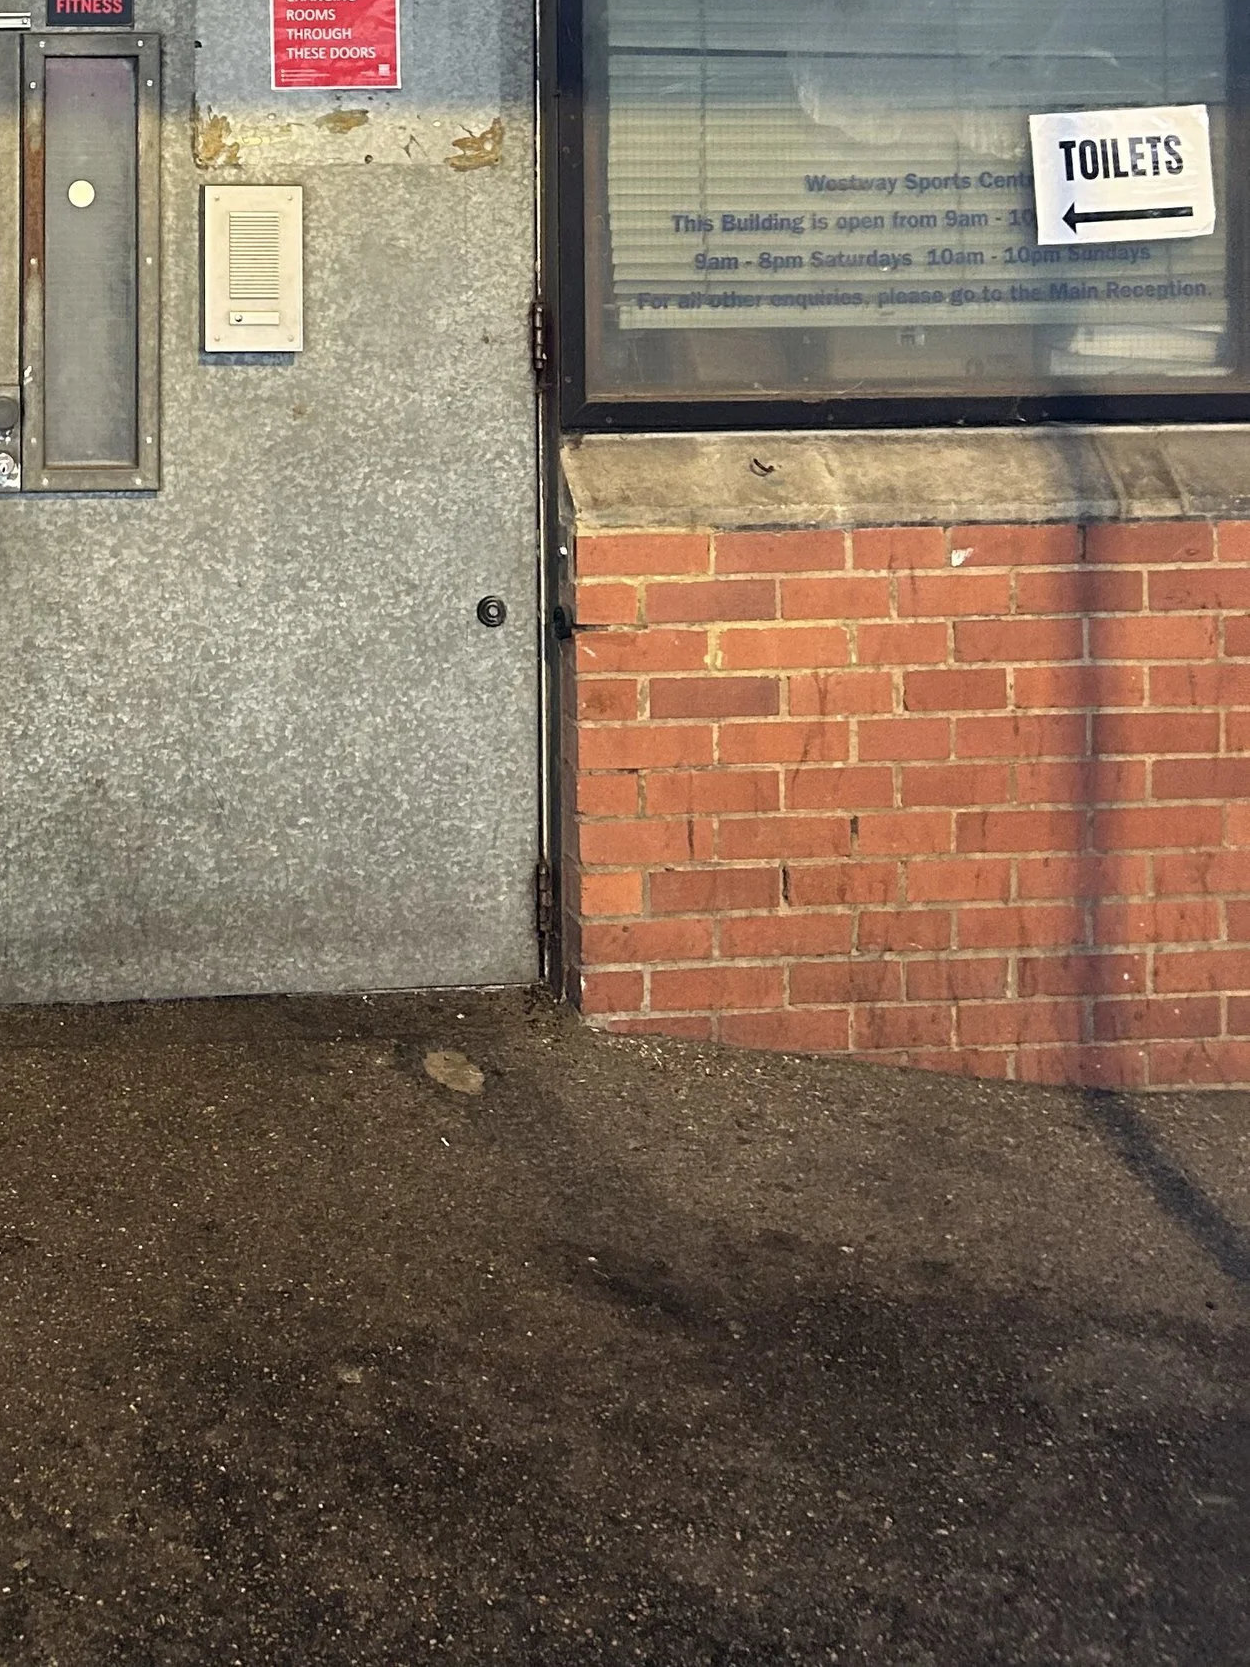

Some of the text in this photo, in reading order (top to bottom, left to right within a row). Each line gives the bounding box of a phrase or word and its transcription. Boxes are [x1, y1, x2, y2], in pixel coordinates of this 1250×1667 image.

[286, 8, 336, 21] ROOMS
[286, 27, 352, 40] THROUGH
[286, 46, 377, 60] THESE DOORS
[1058, 134, 1184, 182] TOILETS
[804, 174, 897, 195] Westway
[904, 172, 971, 194] Sports
[671, 214, 715, 233] This
[720, 212, 805, 234] Building
[810, 212, 828, 231] is
[836, 213, 885, 234] open
[892, 210, 938, 229] from
[944, 209, 989, 228] 9am
[694, 252, 739, 271] 9am
[757, 251, 804, 272] 8pm
[810, 248, 913, 271] Saturdays
[926, 247, 985, 267] 10am
[1003, 245, 1061, 267] 10pm
[1067, 243, 1152, 264] Sundays
[636, 292, 671, 309] For
[677, 290, 700, 309] all
[706, 290, 763, 308] other
[877, 287, 948, 309] please
[950, 287, 976, 307] go
[982, 285, 1002, 302] to
[1010, 283, 1044, 303] the
[1050, 282, 1099, 300] Main
[1105, 280, 1213, 302] Reception.
